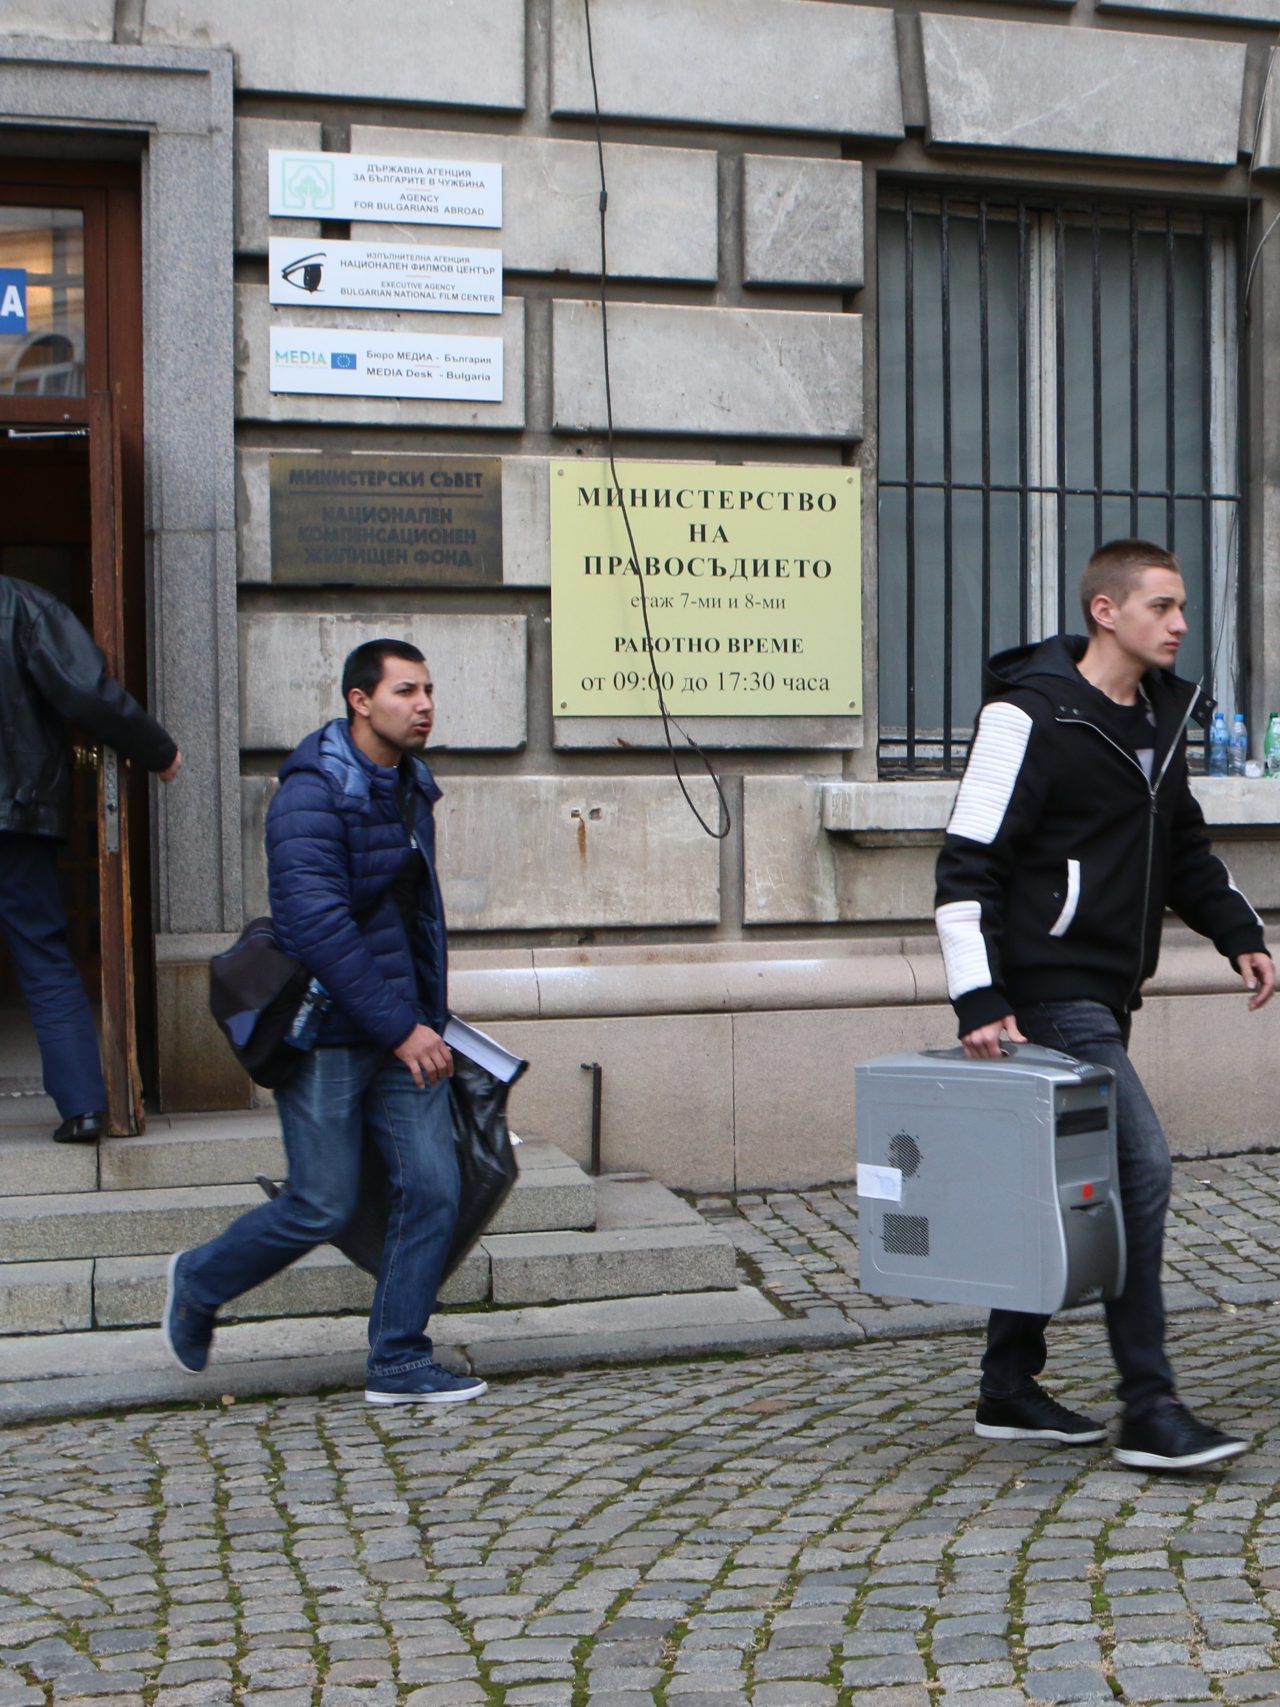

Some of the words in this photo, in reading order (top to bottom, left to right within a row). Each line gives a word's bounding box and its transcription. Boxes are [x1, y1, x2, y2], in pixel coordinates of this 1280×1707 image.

[367, 164, 423, 176] ДЪРЖАВНА
[426, 167, 472, 179] АГЕНЦИЯ
[353, 173, 366, 182] ЗА
[370, 174, 426, 186] БЪЛГАРИТЕ
[429, 178, 435, 186] В
[438, 179, 485, 188] ЧУЖБИНА
[400, 194, 439, 203] AGENCY
[354, 201, 374, 210] FOR
[377, 203, 439, 213] BULGARIANS
[444, 206, 484, 216] ABROAD
[366, 252, 431, 263] ИЗПЪЛНИТЕЛНА
[433, 255, 470, 265] АГЕНЦИЯ
[340, 259, 408, 272] НАЦИОНАЛЕН
[411, 263, 454, 273] ФИЛМОВ
[456, 265, 495, 276] ЦЕНТЪР
[381, 281, 422, 290] EXECUTIVE
[425, 283, 455, 291] AGENCY
[1, 285, 25, 317] A
[340, 288, 392, 297] BULGARIAN
[394, 290, 437, 299] NATIONAL
[439, 292, 459, 300] FILM
[461, 294, 495, 302] CENTER
[275, 350, 327, 366] MEDIA
[366, 350, 394, 362] Бюро
[397, 352, 432, 363] МЕДИА
[445, 354, 492, 366] България
[367, 368, 403, 378] MEDIA
[406, 369, 432, 379] Desk
[446, 372, 491, 383] Bulgaria
[289, 469, 425, 487] МИНИСТЕРСКИ
[430, 472, 483, 488] СЪВЕТ
[577, 487, 837, 512] МИНИСТЕРСТВО
[322, 506, 453, 525] НАЦИОНАЛЕН
[689, 523, 729, 543] НА
[413, 551, 473, 567] ФОНД
[584, 556, 832, 581] ПРАВОСЪДИЕТО
[680, 592, 722, 609] 7-ми
[728, 597, 739, 609] и
[745, 593, 786, 609] 8-ми
[614, 637, 720, 654] РАБОТНО
[728, 638, 804, 654] ВРЕМЕ
[581, 675, 605, 690] от
[613, 671, 673, 690] 09:00
[681, 675, 708, 693] до
[718, 672, 775, 691] 17:30
[783, 676, 829, 691] часа
